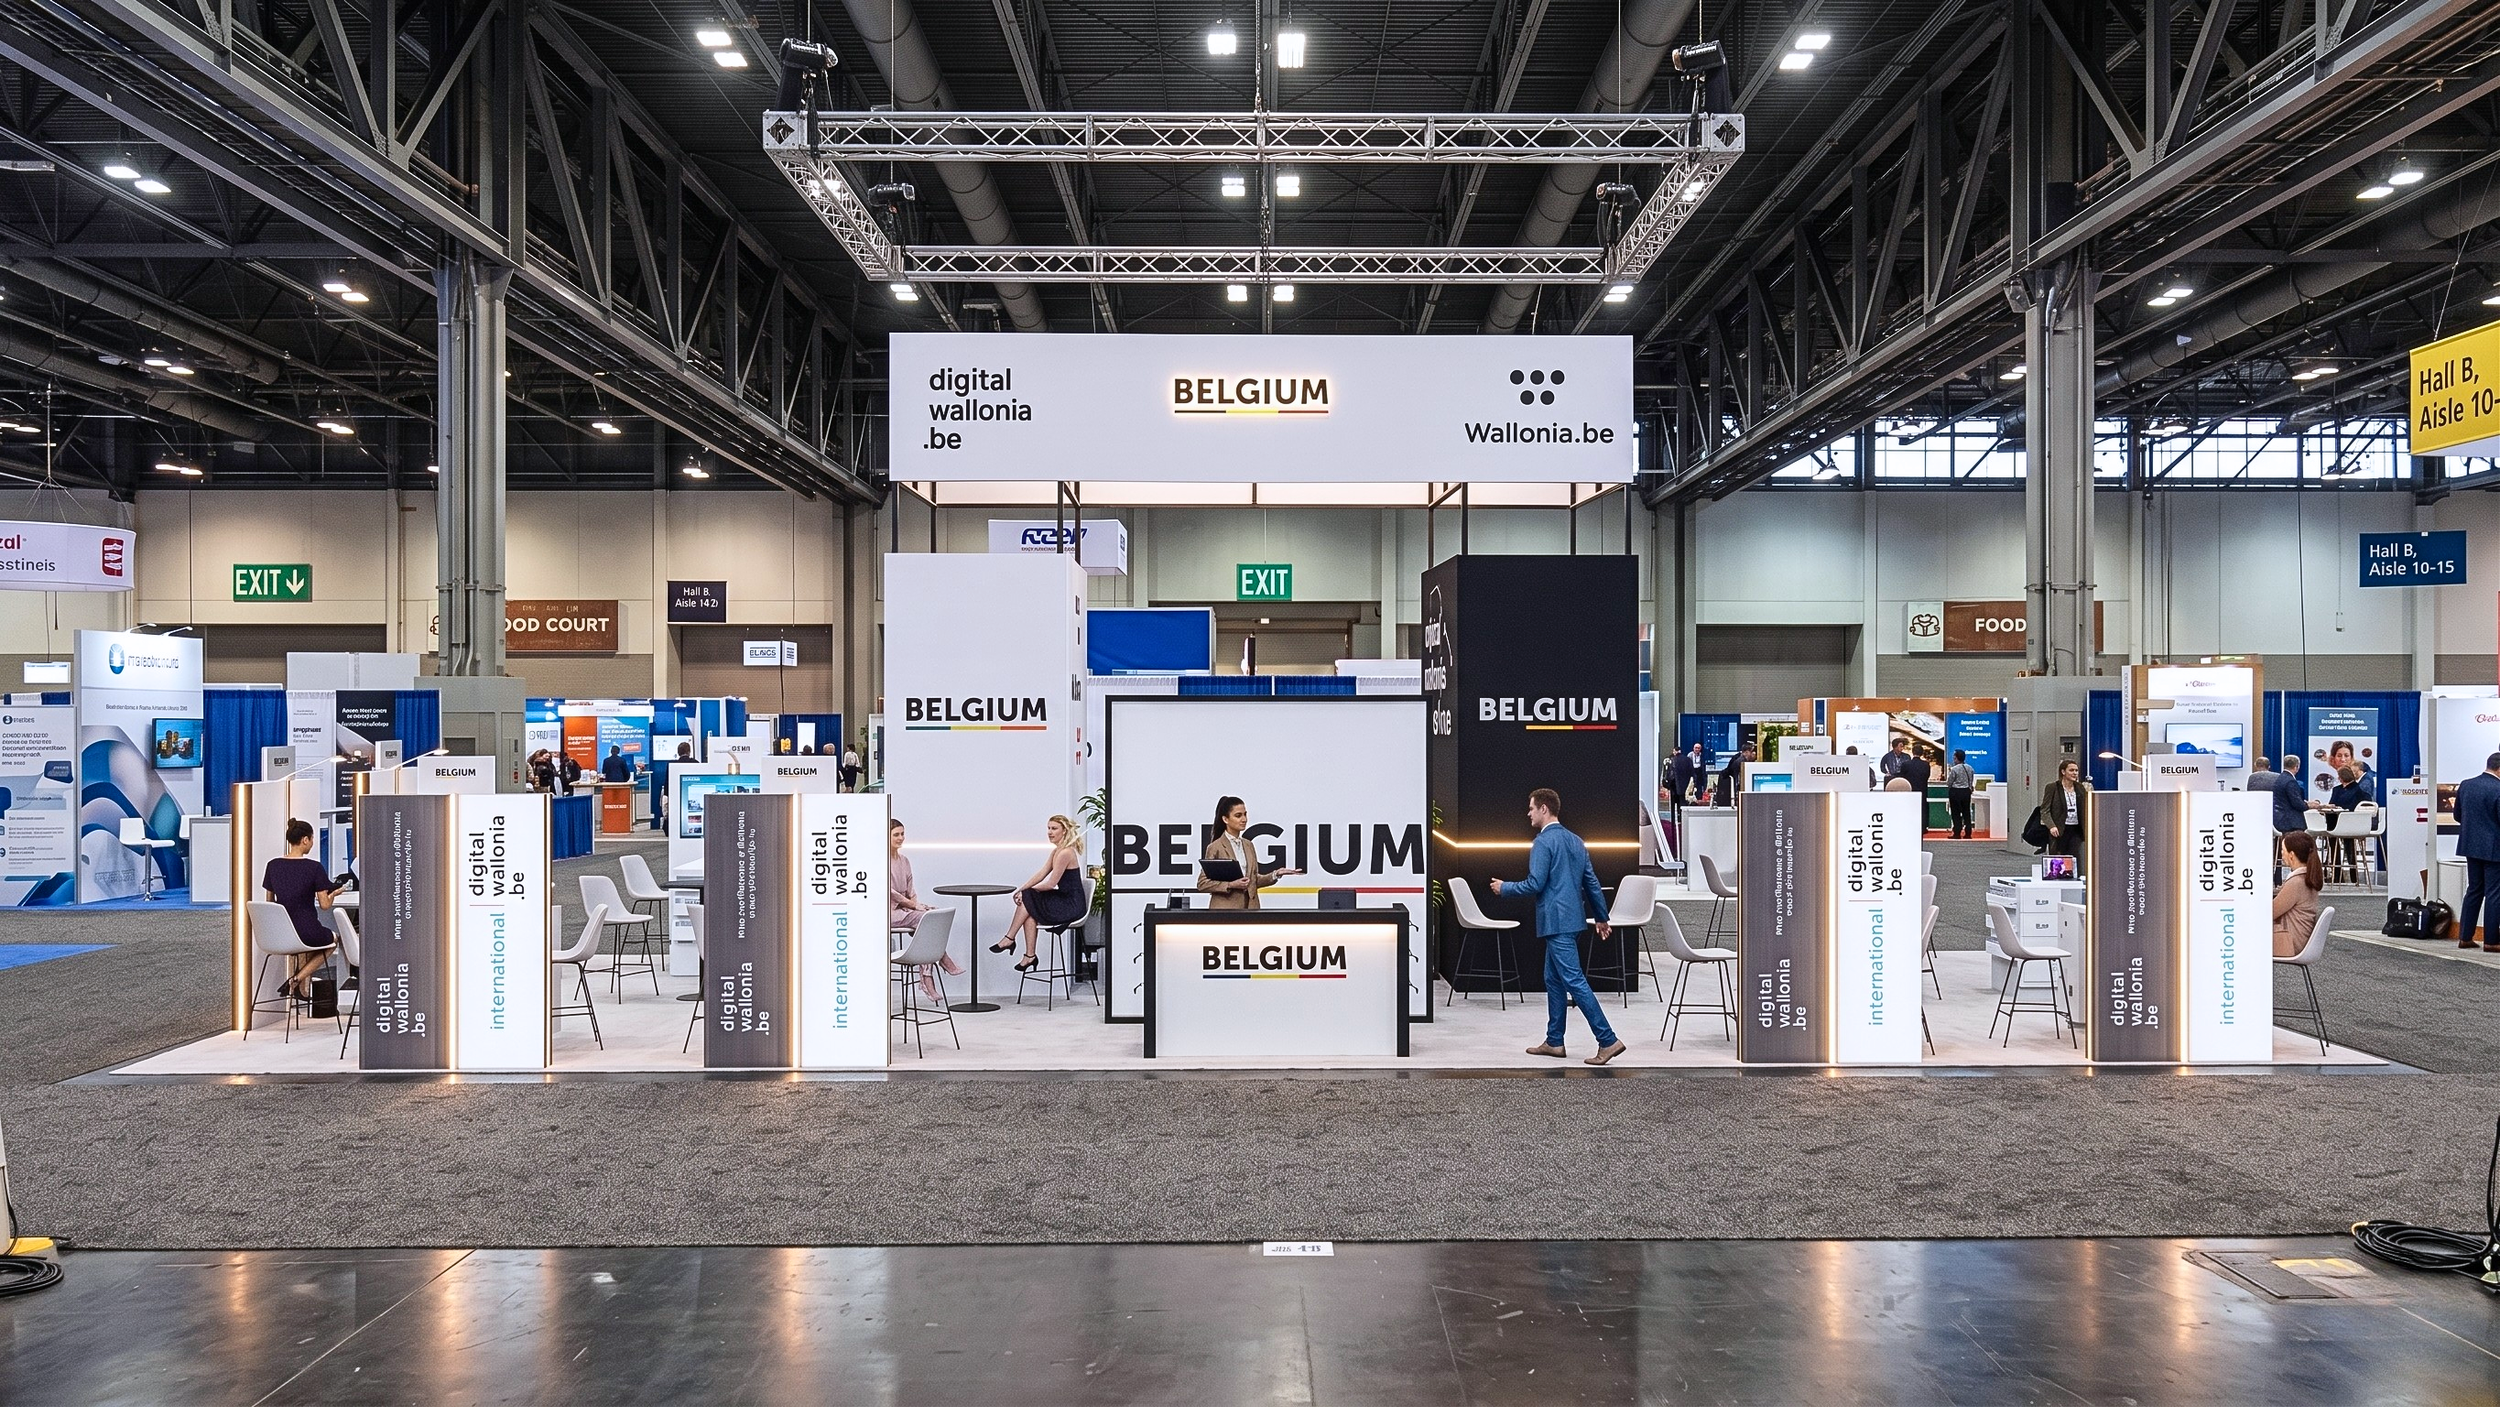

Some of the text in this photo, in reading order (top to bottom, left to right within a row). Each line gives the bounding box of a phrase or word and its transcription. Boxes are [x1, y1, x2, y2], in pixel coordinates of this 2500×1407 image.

[929, 367, 1011, 398] digital
[2419, 356, 2480, 396] Hall B,
[1174, 378, 1329, 405] BELGIUM
[928, 398, 1032, 422] wallonia
[2418, 396, 2465, 432] Aisle
[923, 426, 962, 450] .be
[1464, 421, 1614, 444] Wallonia.be
[2370, 542, 2418, 560] Hall B,
[235, 569, 282, 596] EXIT
[1241, 569, 1289, 596] EXIT
[2368, 560, 2455, 577] Aisle 10-15
[674, 598, 697, 608] Aisle
[683, 586, 701, 597] Hall
[545, 617, 610, 632] COURT
[1974, 617, 2026, 633] FOOD
[906, 697, 1047, 723] BELGIUM
[1479, 697, 1618, 722] BELGIUM
[435, 768, 477, 777] BELGIUM
[777, 768, 818, 776] BELGIUM
[1810, 766, 1850, 775] BELGIUM
[2160, 766, 2199, 774] BELGIUM
[490, 815, 505, 897] wallonia
[811, 831, 831, 895] digital
[832, 814, 848, 896] wallonia
[1112, 823, 1425, 875] BEGIUM
[1847, 829, 1867, 892] digital
[1868, 812, 1884, 893] wallonia
[2199, 829, 2218, 892] digital
[2219, 812, 2235, 892] wallonia
[469, 832, 488, 897] digital
[509, 872, 525, 900] .be
[850, 871, 868, 899] .be
[1886, 868, 1903, 896] .be
[2237, 868, 2254, 895] .be
[489, 912, 505, 1030] international
[832, 911, 848, 1029] international
[1202, 945, 1347, 970] BELGIUM
[1868, 908, 1884, 1026] international
[2219, 908, 2235, 1025] international
[376, 974, 396, 1033] digital
[396, 963, 409, 1035] wallonia
[720, 975, 738, 1032] digital
[738, 962, 753, 1033] wallonia
[1757, 973, 1776, 1028] digital
[1776, 958, 1791, 1029] wallonia
[2128, 957, 2143, 1027] wallonia
[410, 1012, 426, 1038] .be
[755, 1011, 770, 1036] .be
[1792, 1006, 1807, 1031] .be
[2144, 1005, 2159, 1030] .be
